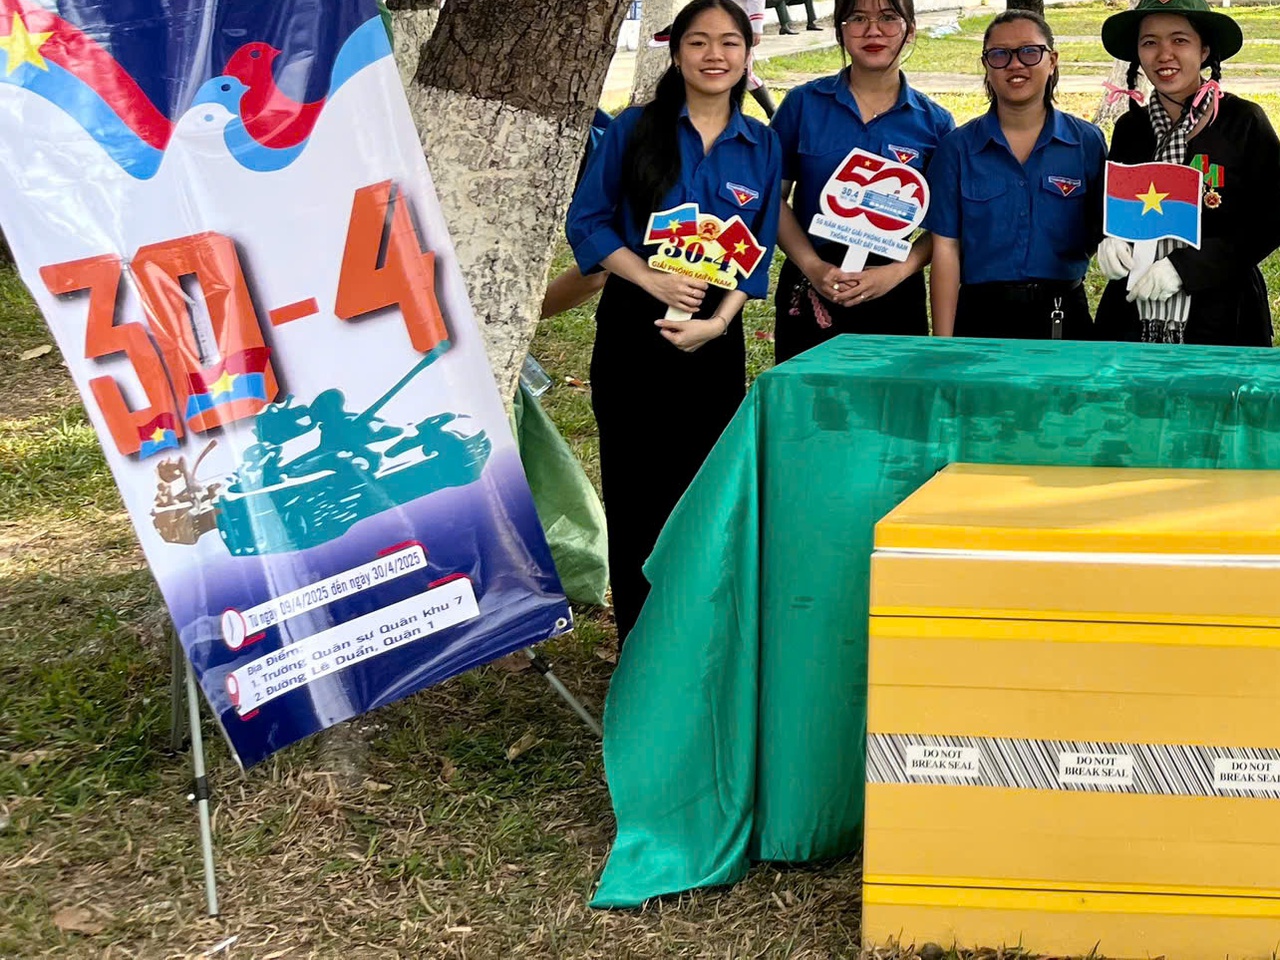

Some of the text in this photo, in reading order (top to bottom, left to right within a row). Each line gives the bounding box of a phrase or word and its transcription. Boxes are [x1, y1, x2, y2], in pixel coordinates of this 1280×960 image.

[841, 187, 859, 198] 30.4
[279, 551, 421, 616] 09/4/2025 đến ngày 30/4/2025
[379, 595, 464, 635] Quân khu 7
[383, 628, 422, 647] Quận
[427, 621, 434, 630] 1
[923, 749, 963, 759] DO NOT
[912, 759, 975, 771] BREAK SEAL
[1077, 756, 1117, 766] DO NOT
[1065, 767, 1129, 778] BREAK SEAL
[1231, 762, 1272, 772] DO NOT
[1220, 772, 1256, 782] BREAK
